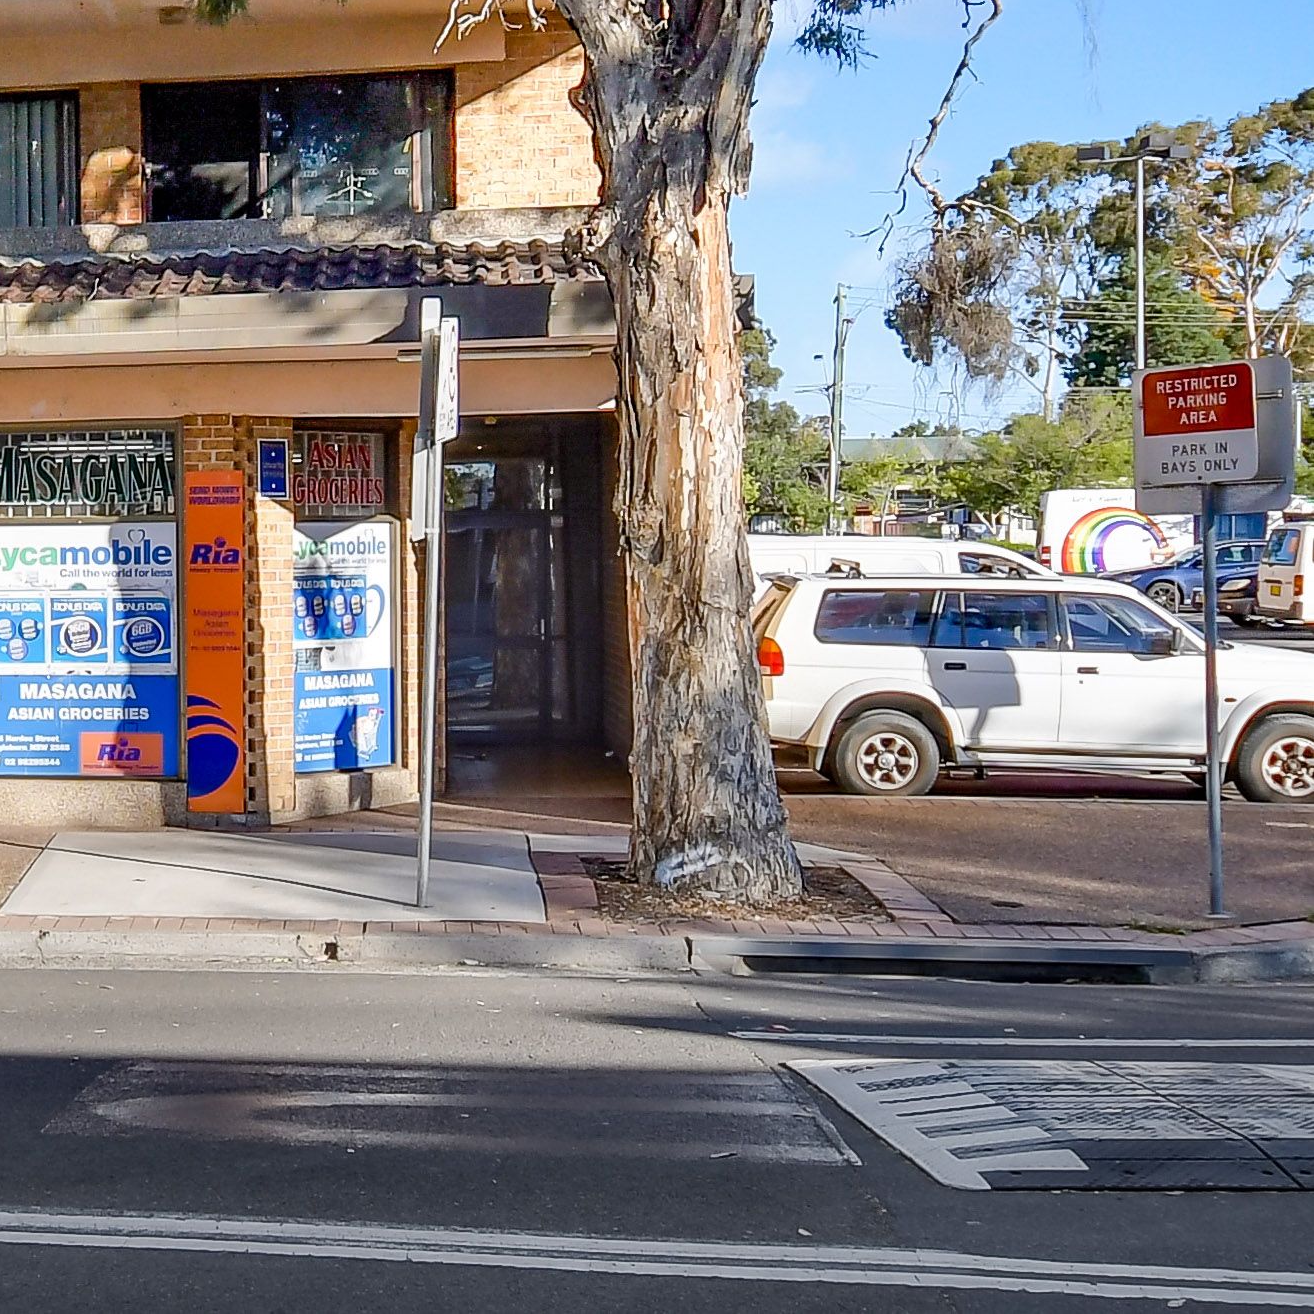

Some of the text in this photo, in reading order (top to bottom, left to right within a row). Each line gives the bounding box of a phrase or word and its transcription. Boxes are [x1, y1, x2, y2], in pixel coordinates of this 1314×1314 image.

[1156, 374, 1237, 394] RESTRICTED
[1168, 392, 1227, 409] PARKING
[1180, 410, 1217, 425] AREA
[309, 440, 371, 470] ASIAN
[1172, 442, 1228, 457] PARK IN
[1161, 458, 1239, 474] BAYS ONLY
[293, 473, 384, 506] GROCERIES
[190, 536, 240, 564] Ria
[60, 568, 173, 578] Call the world for less
[304, 673, 375, 691] MASAGANA
[20, 683, 137, 700] MASAGANA
[299, 693, 380, 710] ASIAN GROCERIES
[7, 707, 150, 720] ASIAN GROCERIES
[97, 738, 141, 761] Ria
